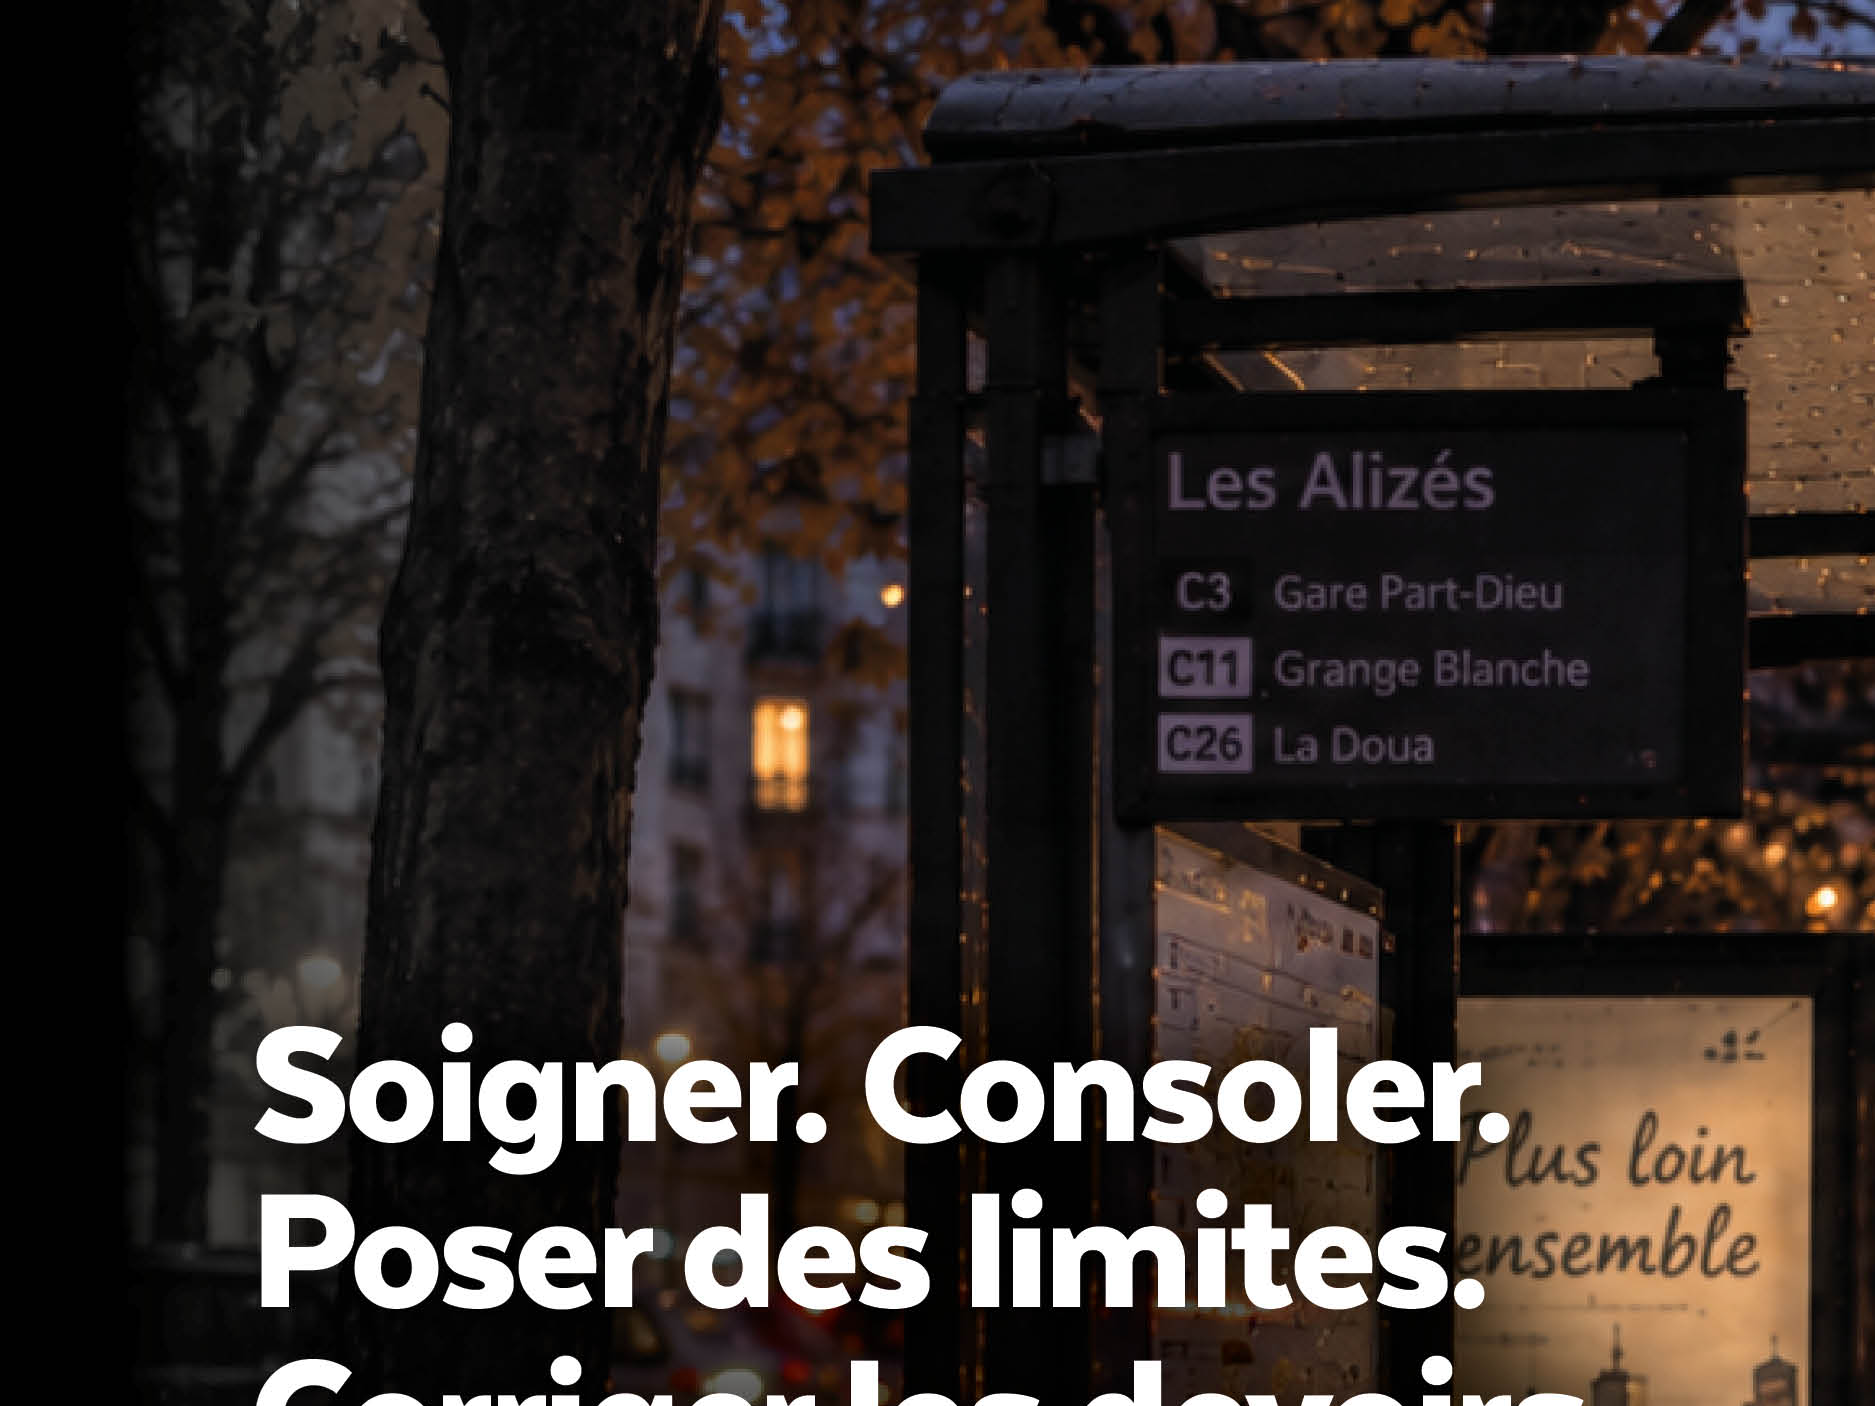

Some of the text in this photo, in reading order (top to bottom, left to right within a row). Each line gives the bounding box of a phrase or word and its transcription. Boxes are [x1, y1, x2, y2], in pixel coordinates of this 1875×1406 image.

[1168, 449, 1495, 510] Les Alizés
[1177, 572, 1563, 611] C3 Gare Part-Dieu
[1168, 650, 1591, 696] C11 Grange Blanche
[1167, 725, 1435, 764] C26 La Doua
[1457, 1109, 1757, 1188] Plus loin
[1455, 1203, 1760, 1280] ensemble
